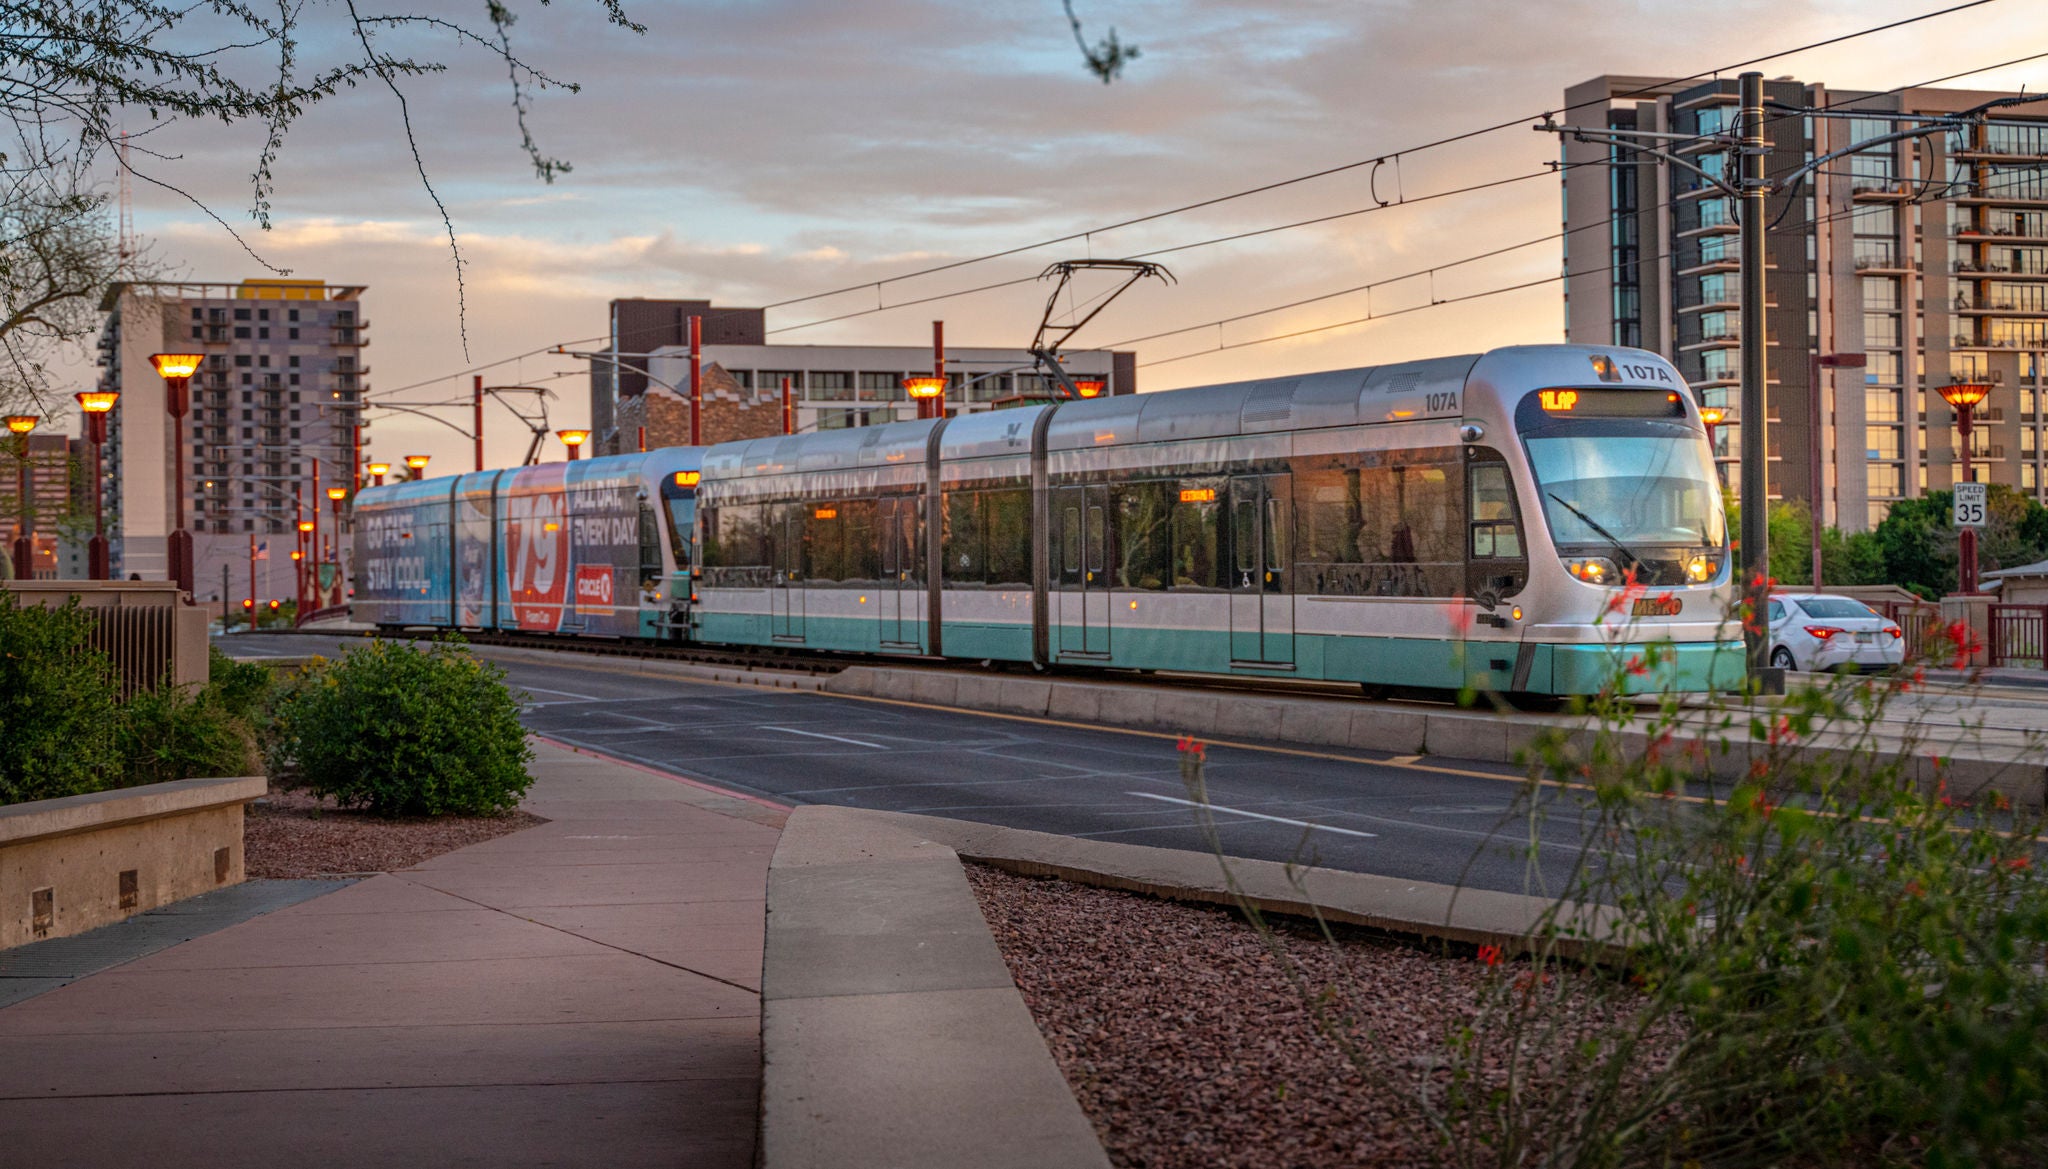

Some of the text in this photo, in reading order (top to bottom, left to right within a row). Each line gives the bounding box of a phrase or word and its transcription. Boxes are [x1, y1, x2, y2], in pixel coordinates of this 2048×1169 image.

[1622, 364, 1673, 383] 107A
[1426, 391, 1458, 412] 107A
[574, 481, 596, 509] ALL
[1956, 485, 1984, 493] SPEED
[1958, 503, 1983, 522] 35
[367, 516, 383, 550] GO
[574, 518, 611, 545] EVERY
[367, 558, 392, 590] STAY
[578, 578, 601, 596] CIRCLE
